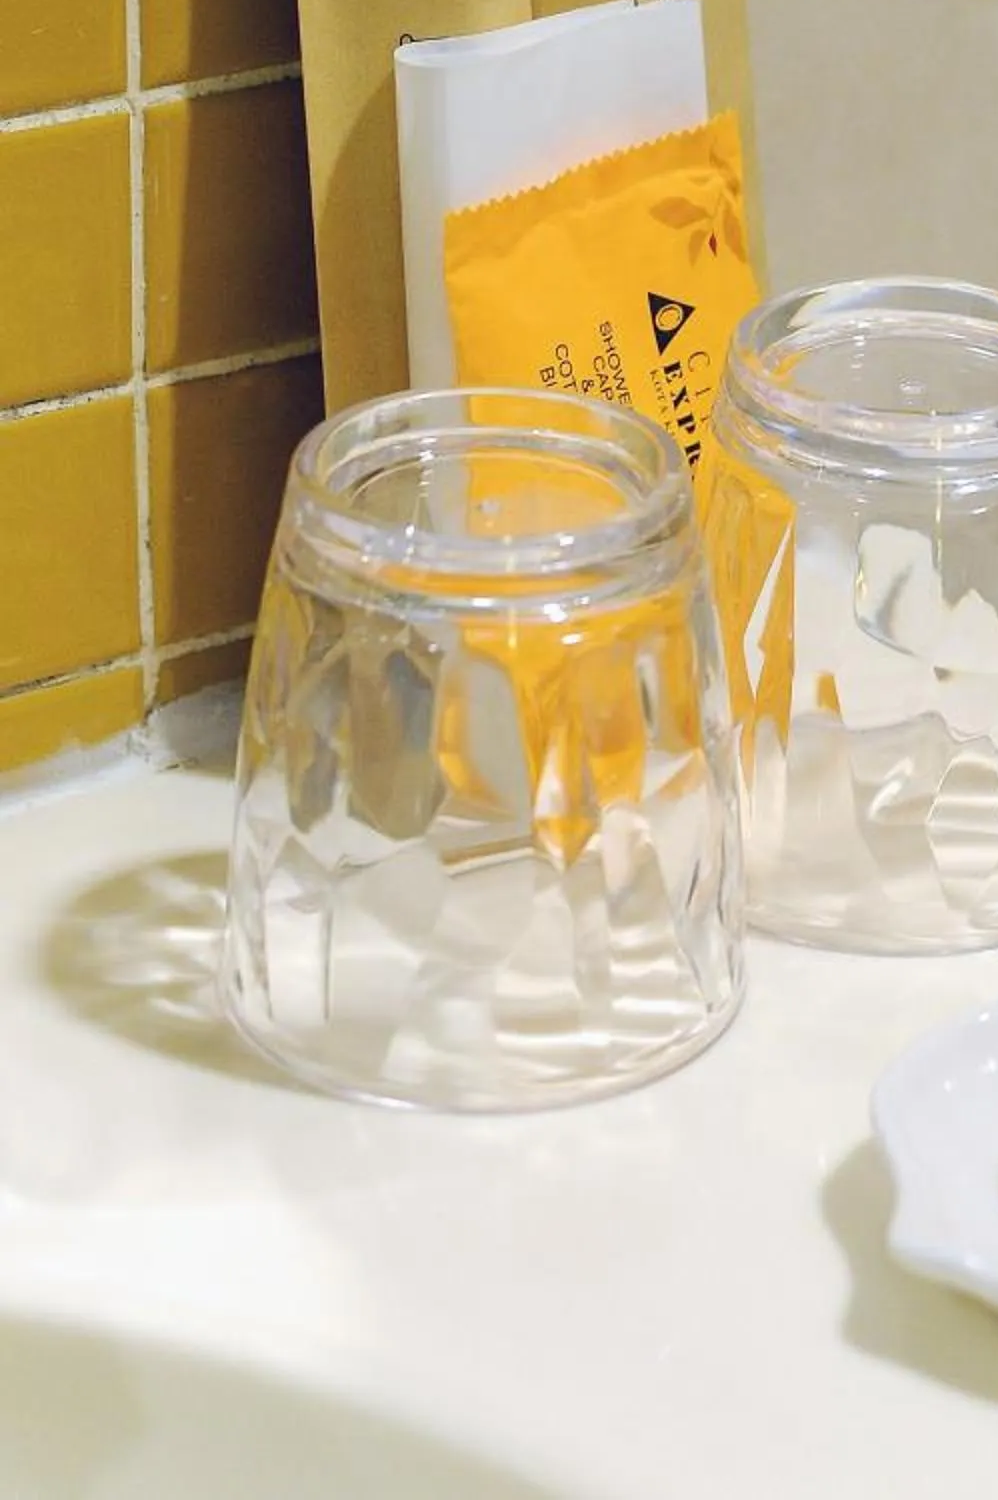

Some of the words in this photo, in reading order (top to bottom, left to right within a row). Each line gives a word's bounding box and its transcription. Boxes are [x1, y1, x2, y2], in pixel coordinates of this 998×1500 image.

[555, 343, 578, 392] COT
[581, 379, 595, 393] &
[593, 355, 614, 401] CAP
[599, 321, 633, 408] SHOWE
[663, 360, 702, 483] EXPR
